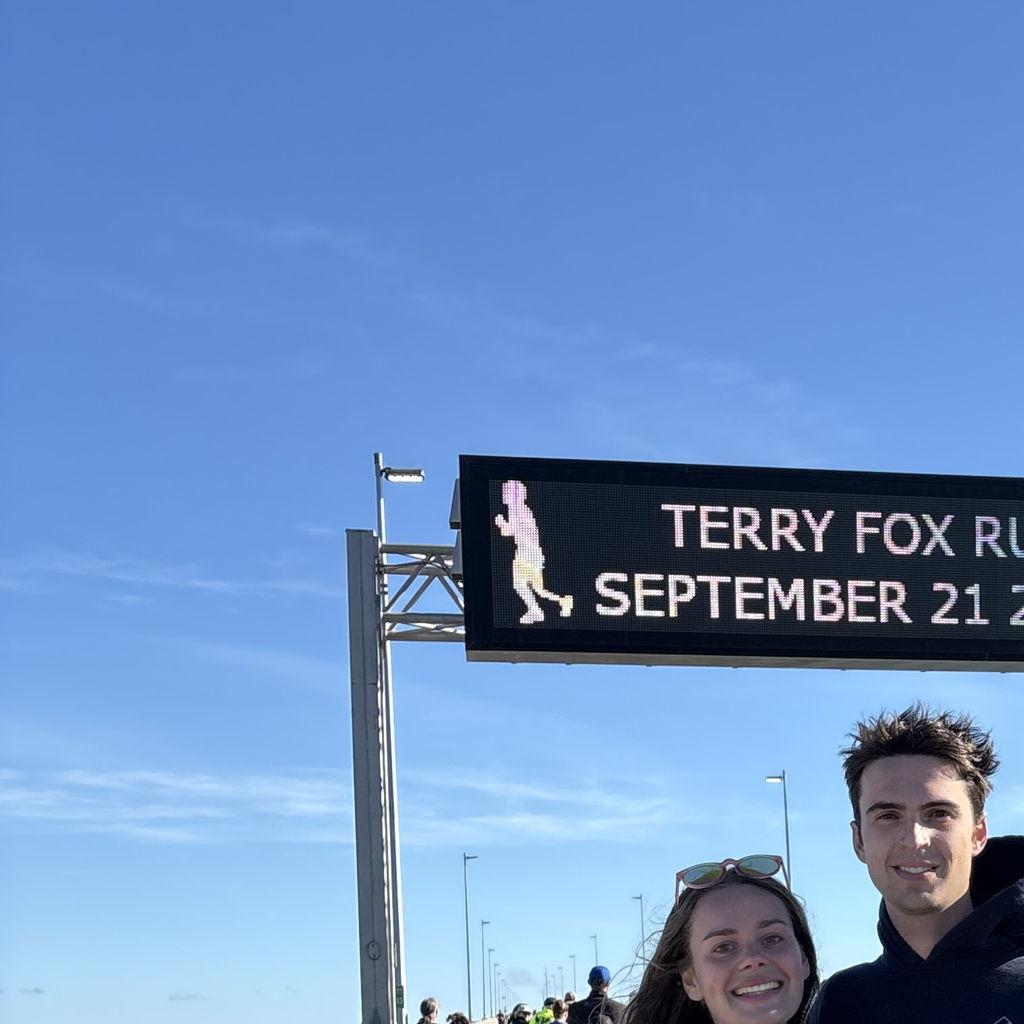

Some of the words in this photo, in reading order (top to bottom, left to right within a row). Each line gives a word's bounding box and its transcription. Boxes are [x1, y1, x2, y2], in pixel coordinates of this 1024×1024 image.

[661, 504, 834, 552] TERRY
[856, 512, 955, 556] FOX
[596, 572, 913, 623] SEPTEMBER
[931, 583, 989, 624] 21
